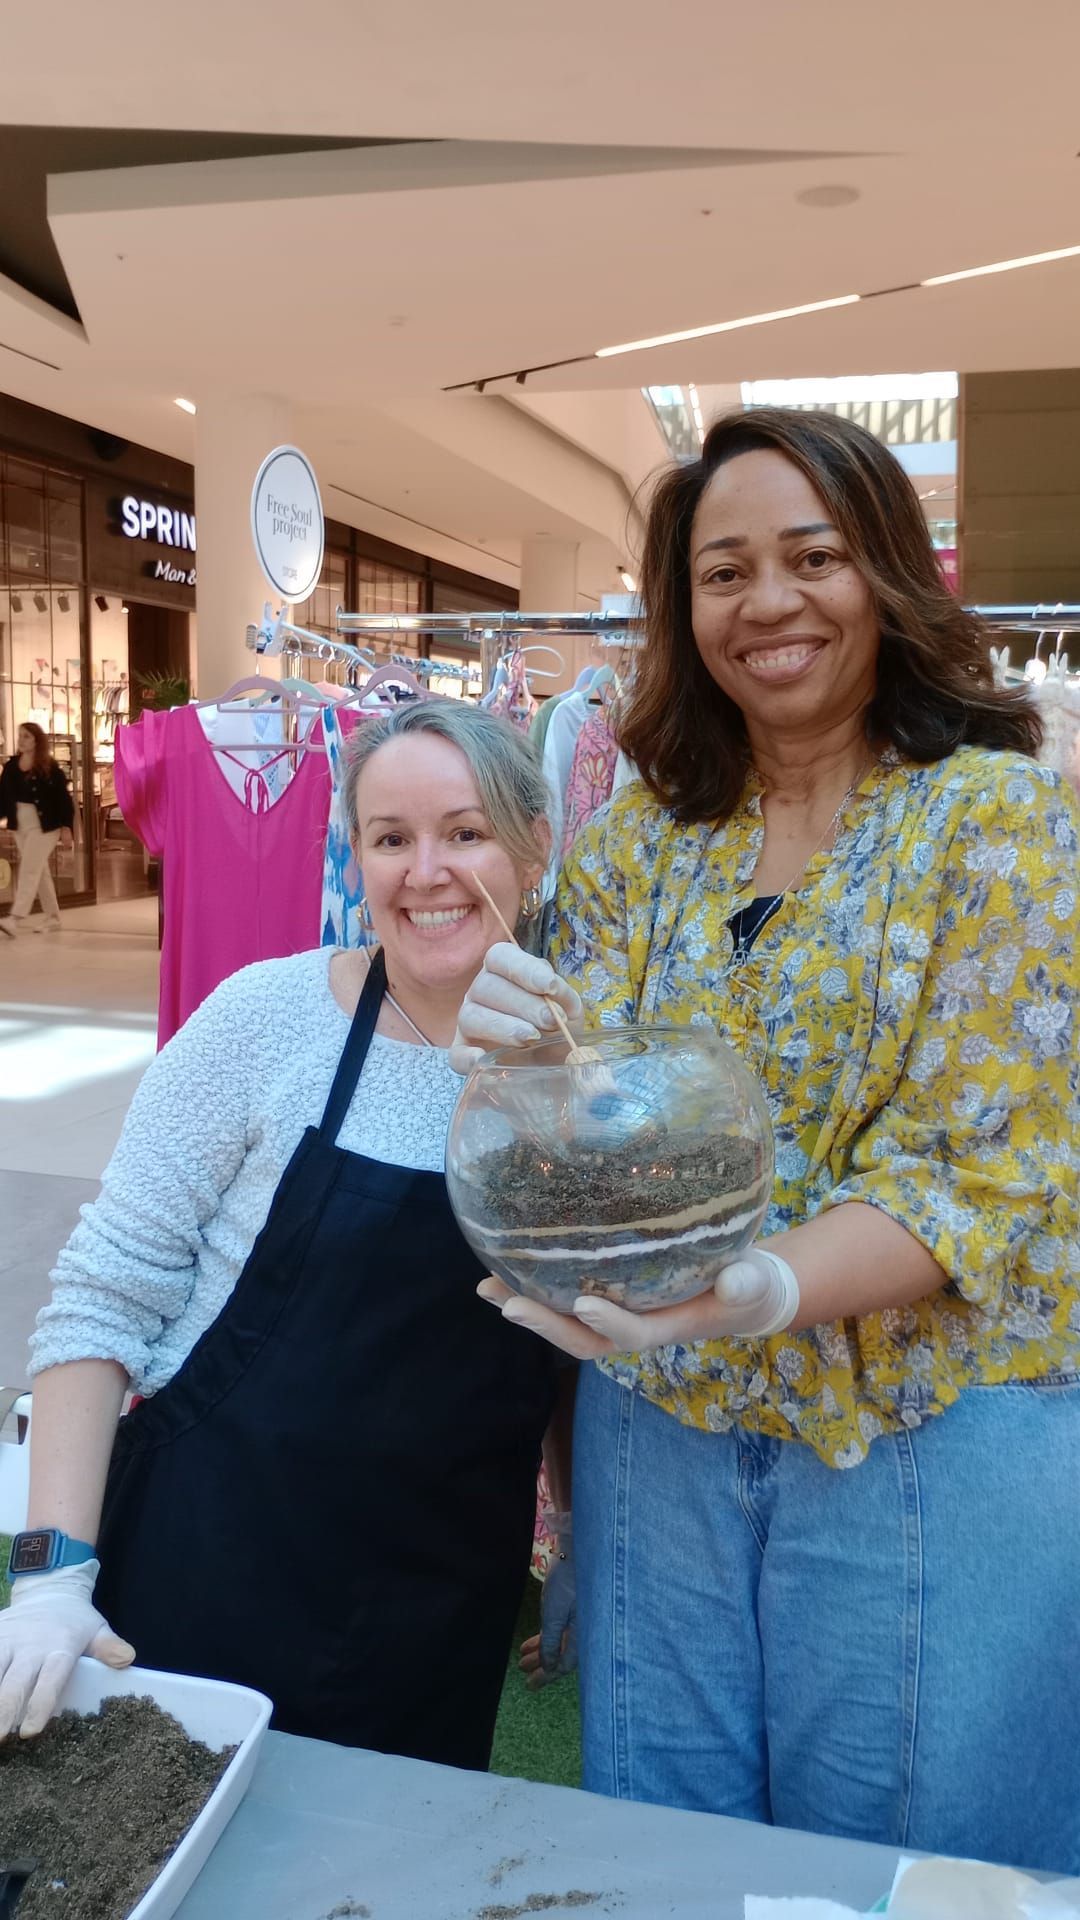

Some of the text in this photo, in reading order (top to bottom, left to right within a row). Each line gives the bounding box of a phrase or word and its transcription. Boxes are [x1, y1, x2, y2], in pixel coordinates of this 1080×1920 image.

[122, 496, 197, 552] SPRIN
[266, 494, 312, 527] Free Soul
[273, 518, 307, 543] project
[155, 559, 186, 583] Man
